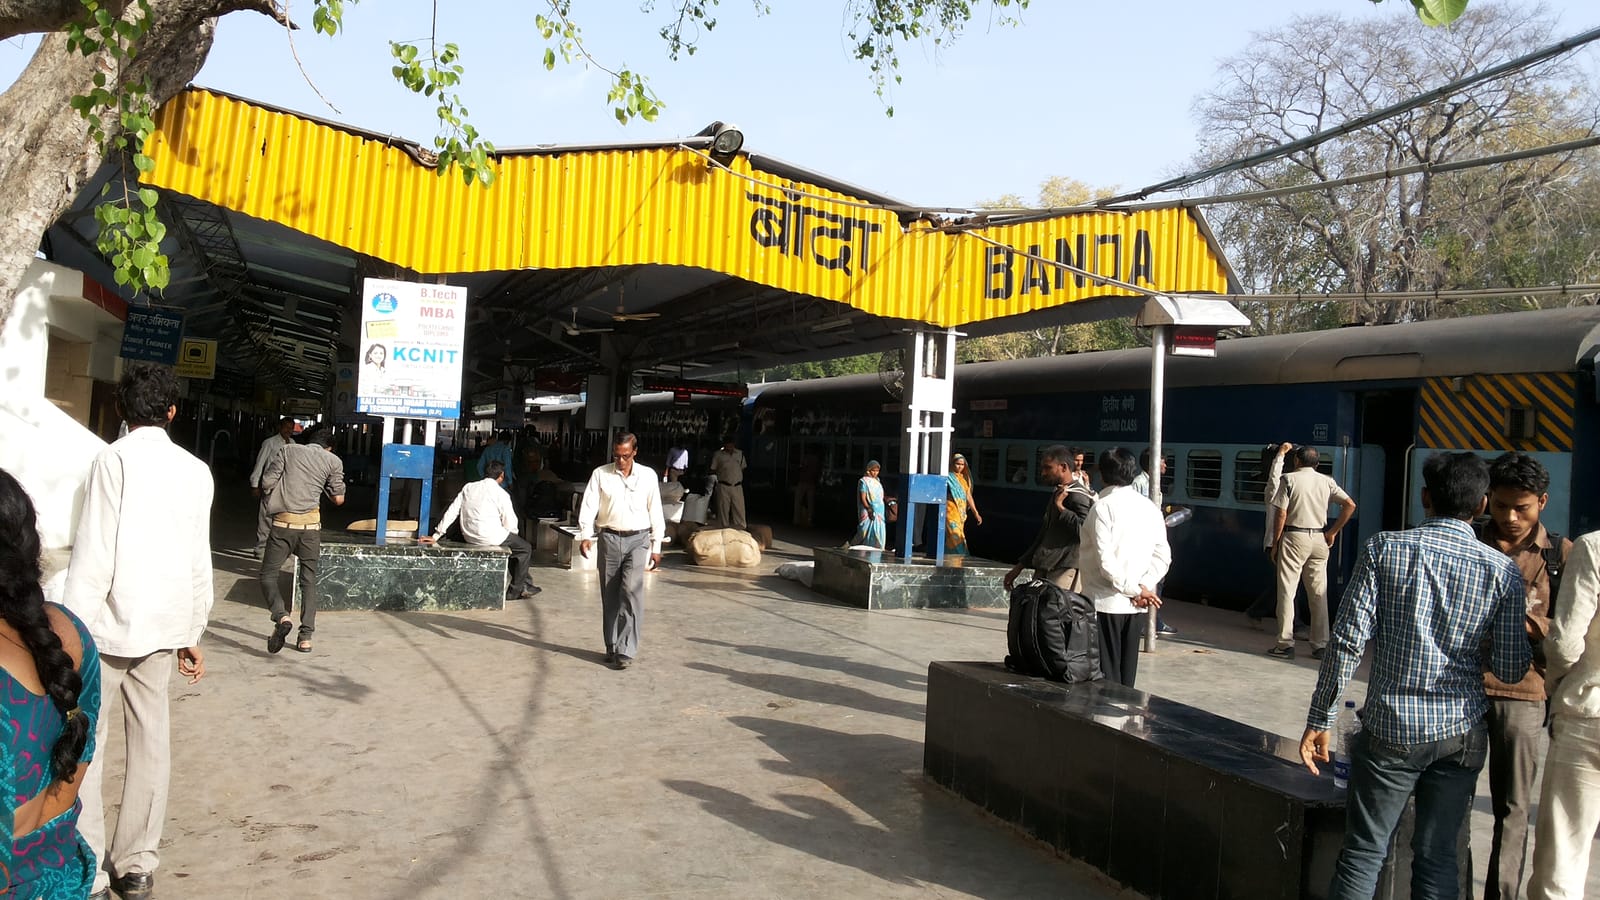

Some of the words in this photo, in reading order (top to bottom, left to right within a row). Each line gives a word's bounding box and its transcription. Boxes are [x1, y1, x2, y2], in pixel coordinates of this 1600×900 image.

[985, 229, 1155, 300] BANDA
[420, 288, 457, 300] B.Tech
[420, 306, 455, 319] MBA
[393, 347, 459, 363] KCNIT
[369, 405, 410, 414] TECHNOLOGY
[426, 400, 457, 409] INSTITUTE
[1100, 418, 1120, 432] SECOND
[1121, 417, 1137, 432] CLASS
